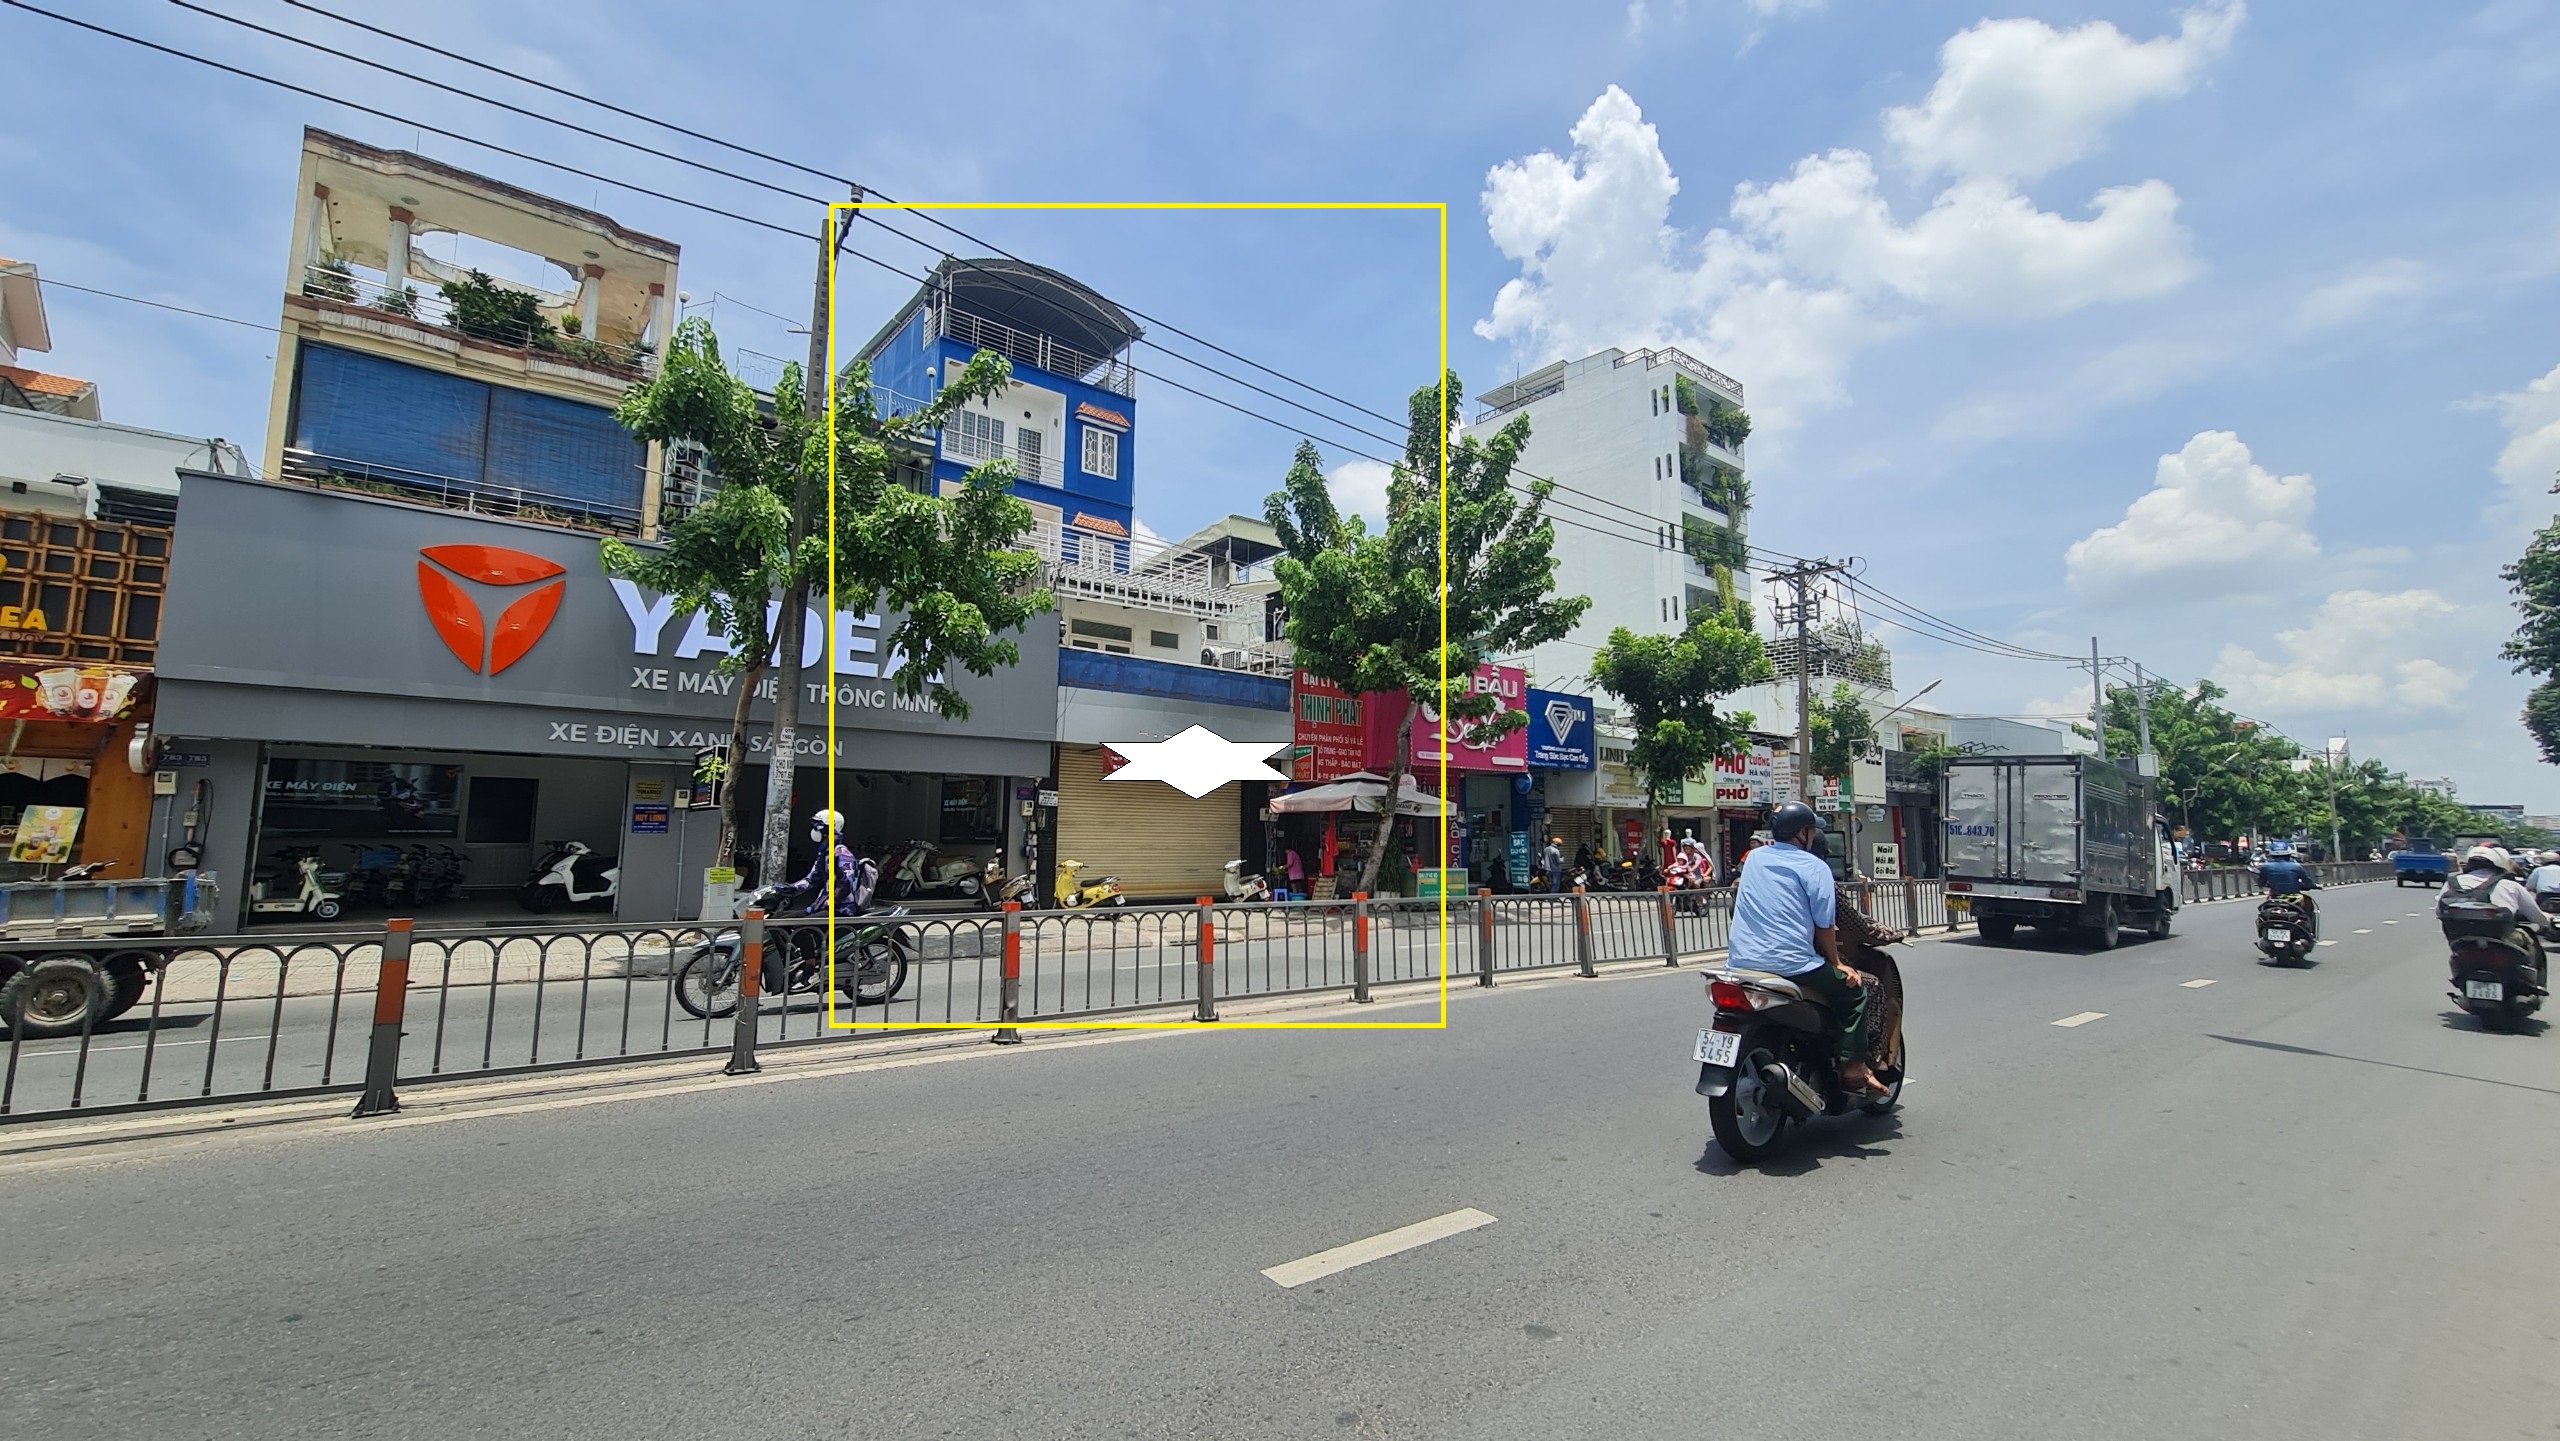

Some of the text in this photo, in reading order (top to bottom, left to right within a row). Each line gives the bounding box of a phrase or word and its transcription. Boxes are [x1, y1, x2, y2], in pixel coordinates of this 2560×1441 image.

[630, 667, 668, 690] XE
[677, 666, 734, 696] MÁY
[806, 682, 886, 708] THÔNG
[1474, 665, 1518, 698] BẦU
[1299, 693, 1333, 728] THỊNH
[549, 722, 587, 742] XE
[594, 724, 659, 749] ĐIỆN
[795, 735, 843, 757] GÒN
[1749, 768, 1771, 778] HÀ NỘI
[286, 779, 319, 790] MÁY
[322, 780, 357, 792] ĐIỆN
[1716, 784, 1749, 800] PHỞ
[1877, 845, 1893, 853] Nail
[1700, 1046, 1731, 1064] 5455
